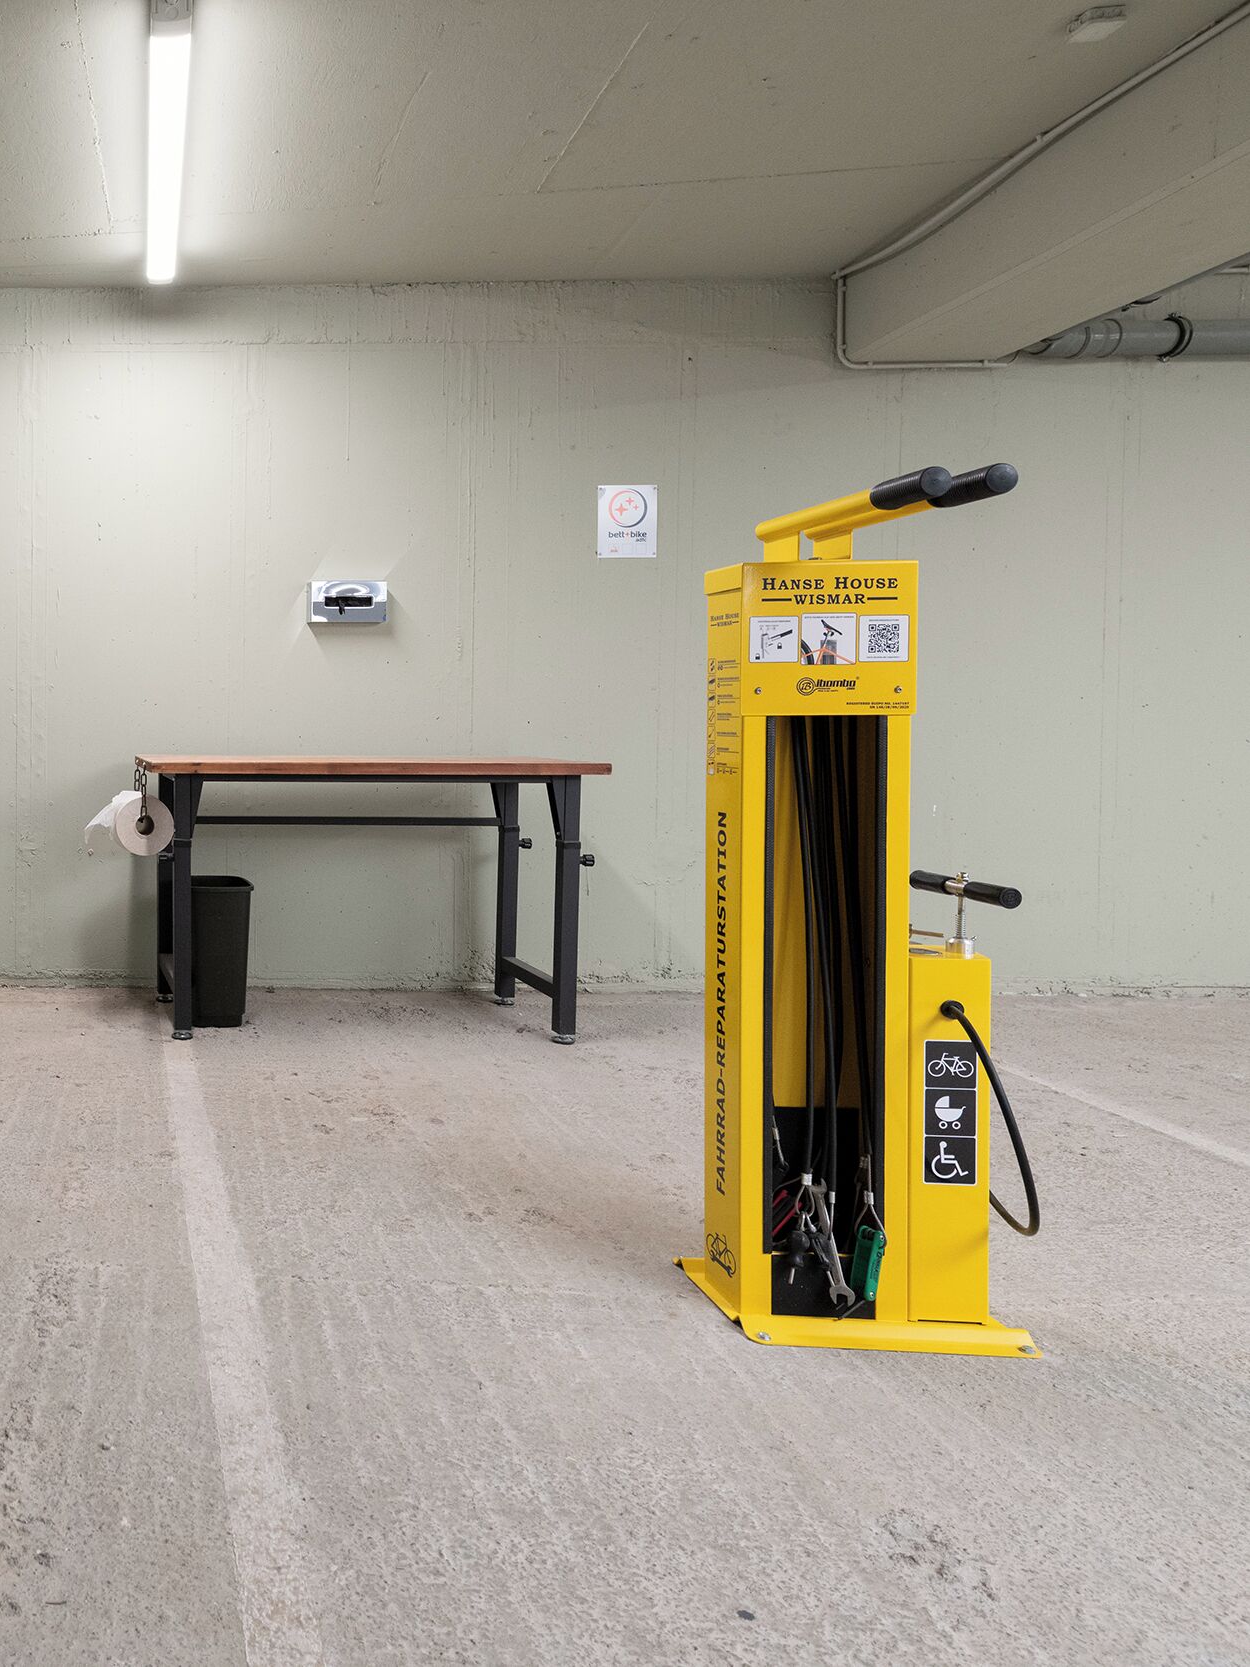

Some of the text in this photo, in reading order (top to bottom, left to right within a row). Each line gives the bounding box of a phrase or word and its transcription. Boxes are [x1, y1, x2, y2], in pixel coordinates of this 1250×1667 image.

[761, 576, 899, 591] HANSE HOUSE
[794, 593, 866, 605] WISMAR
[716, 811, 727, 1196] FAHRRAD-REPARATURSTATION
